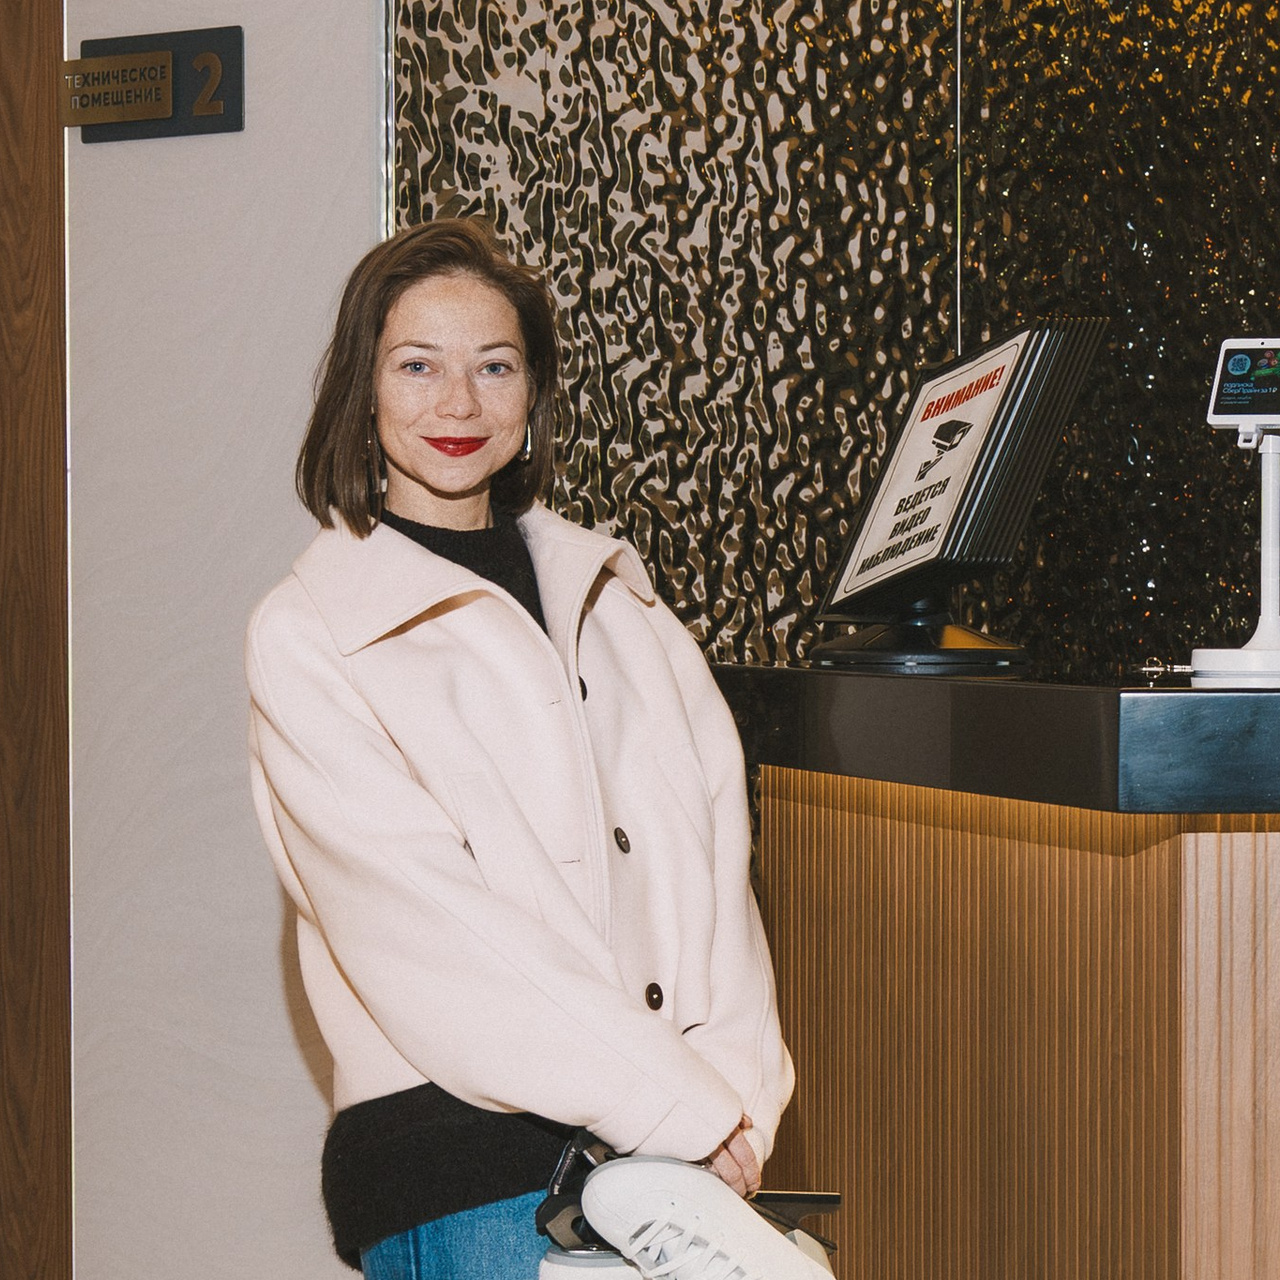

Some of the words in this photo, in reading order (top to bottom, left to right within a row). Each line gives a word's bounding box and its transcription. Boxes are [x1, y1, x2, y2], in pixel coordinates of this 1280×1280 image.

[64, 65, 167, 89] ТЕХНИЧЕСКОЕ
[191, 51, 225, 116] 2
[70, 87, 162, 109] ПОМЕЩЕНИЕ
[920, 364, 1006, 422] ВНИМАНИЕ!
[893, 476, 951, 516] ВЕДЕТСЯ
[888, 506, 932, 540] ВИДЕО
[856, 523, 941, 576] НАБЛЮДЕНИЕ
